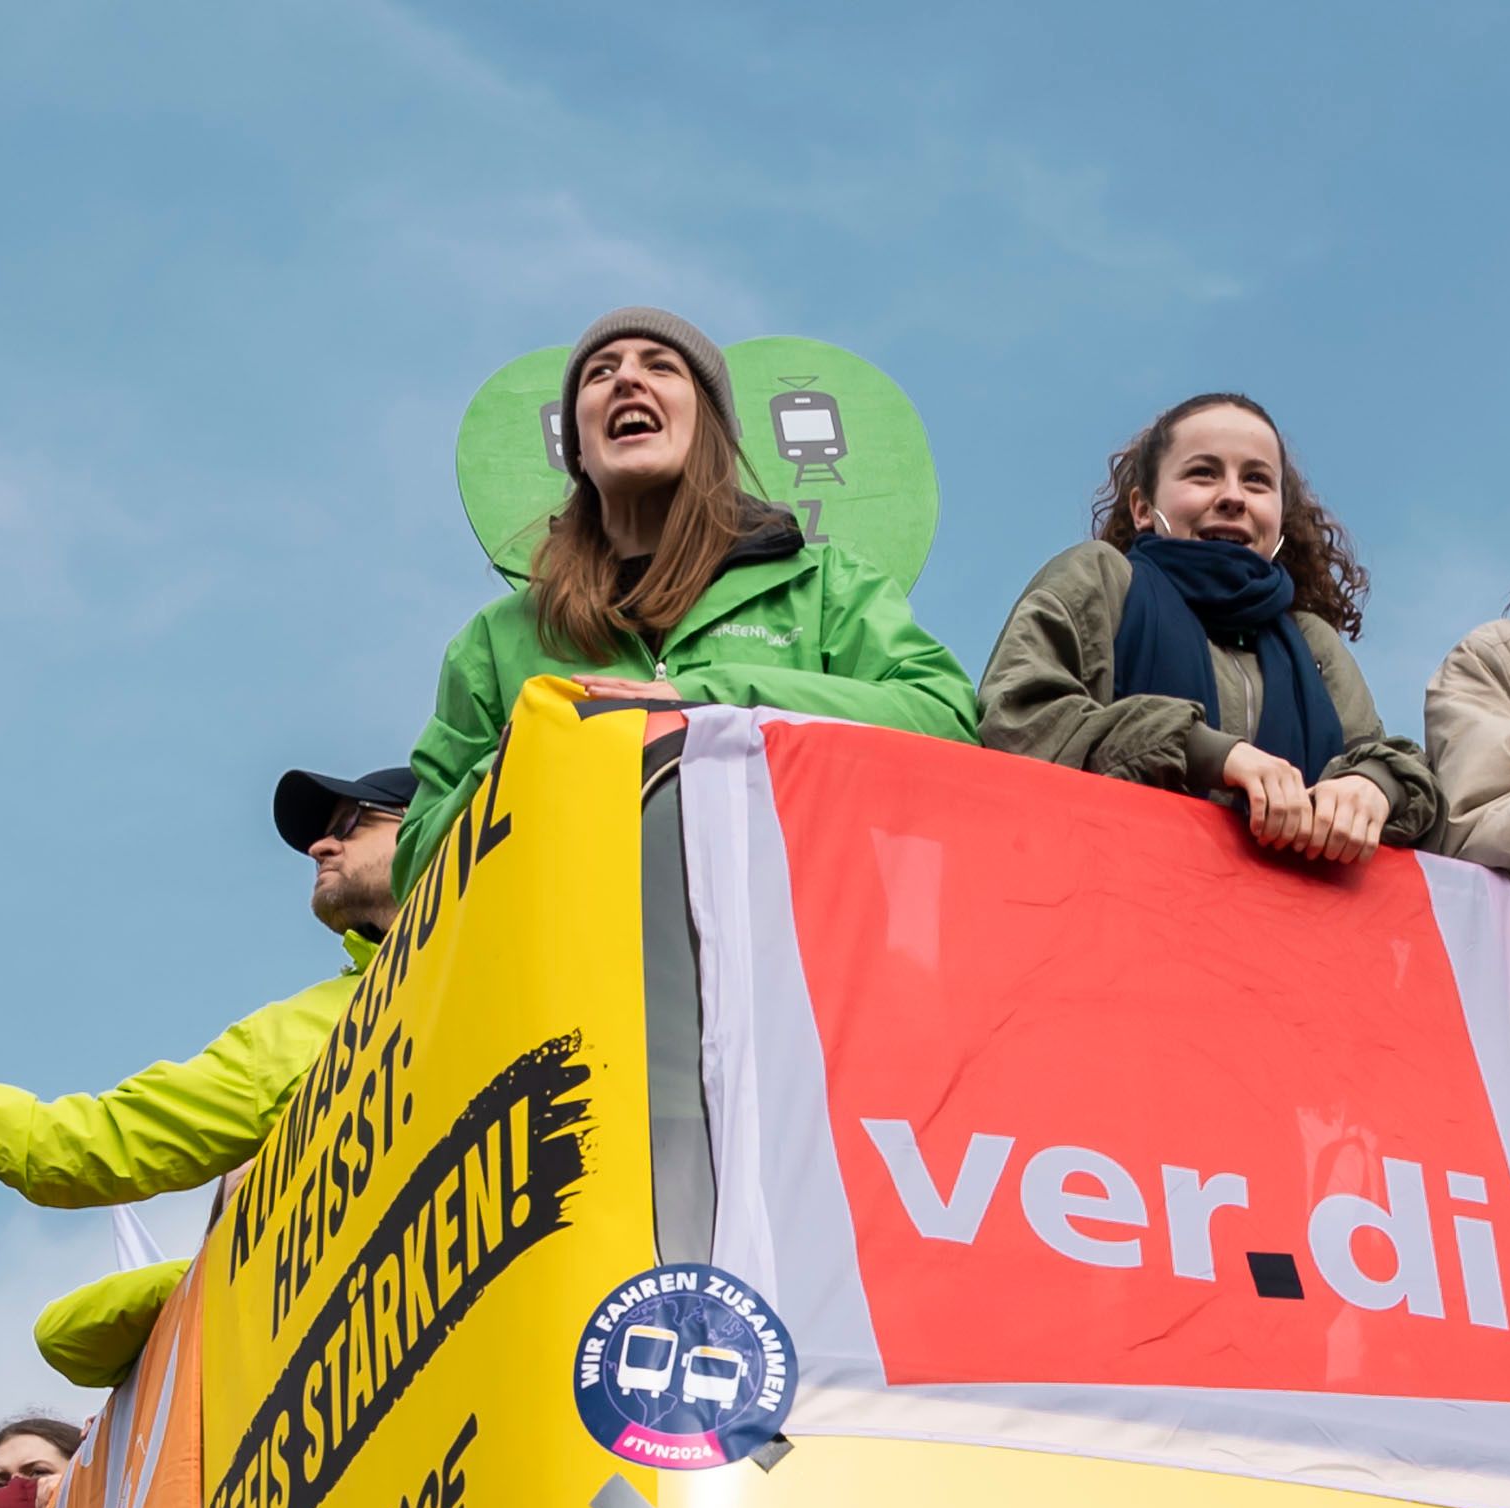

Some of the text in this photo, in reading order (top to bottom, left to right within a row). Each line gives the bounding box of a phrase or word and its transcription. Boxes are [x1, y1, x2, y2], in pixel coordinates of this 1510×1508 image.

[272, 1020, 413, 1342] HEISST:
[860, 1117, 1510, 1331] ver.di
[302, 1095, 532, 1485] STÄRKEN!
[581, 1272, 788, 1412] WIR FAHREN ZUSAMMEN
[622, 1436, 714, 1461] #TVN2024
